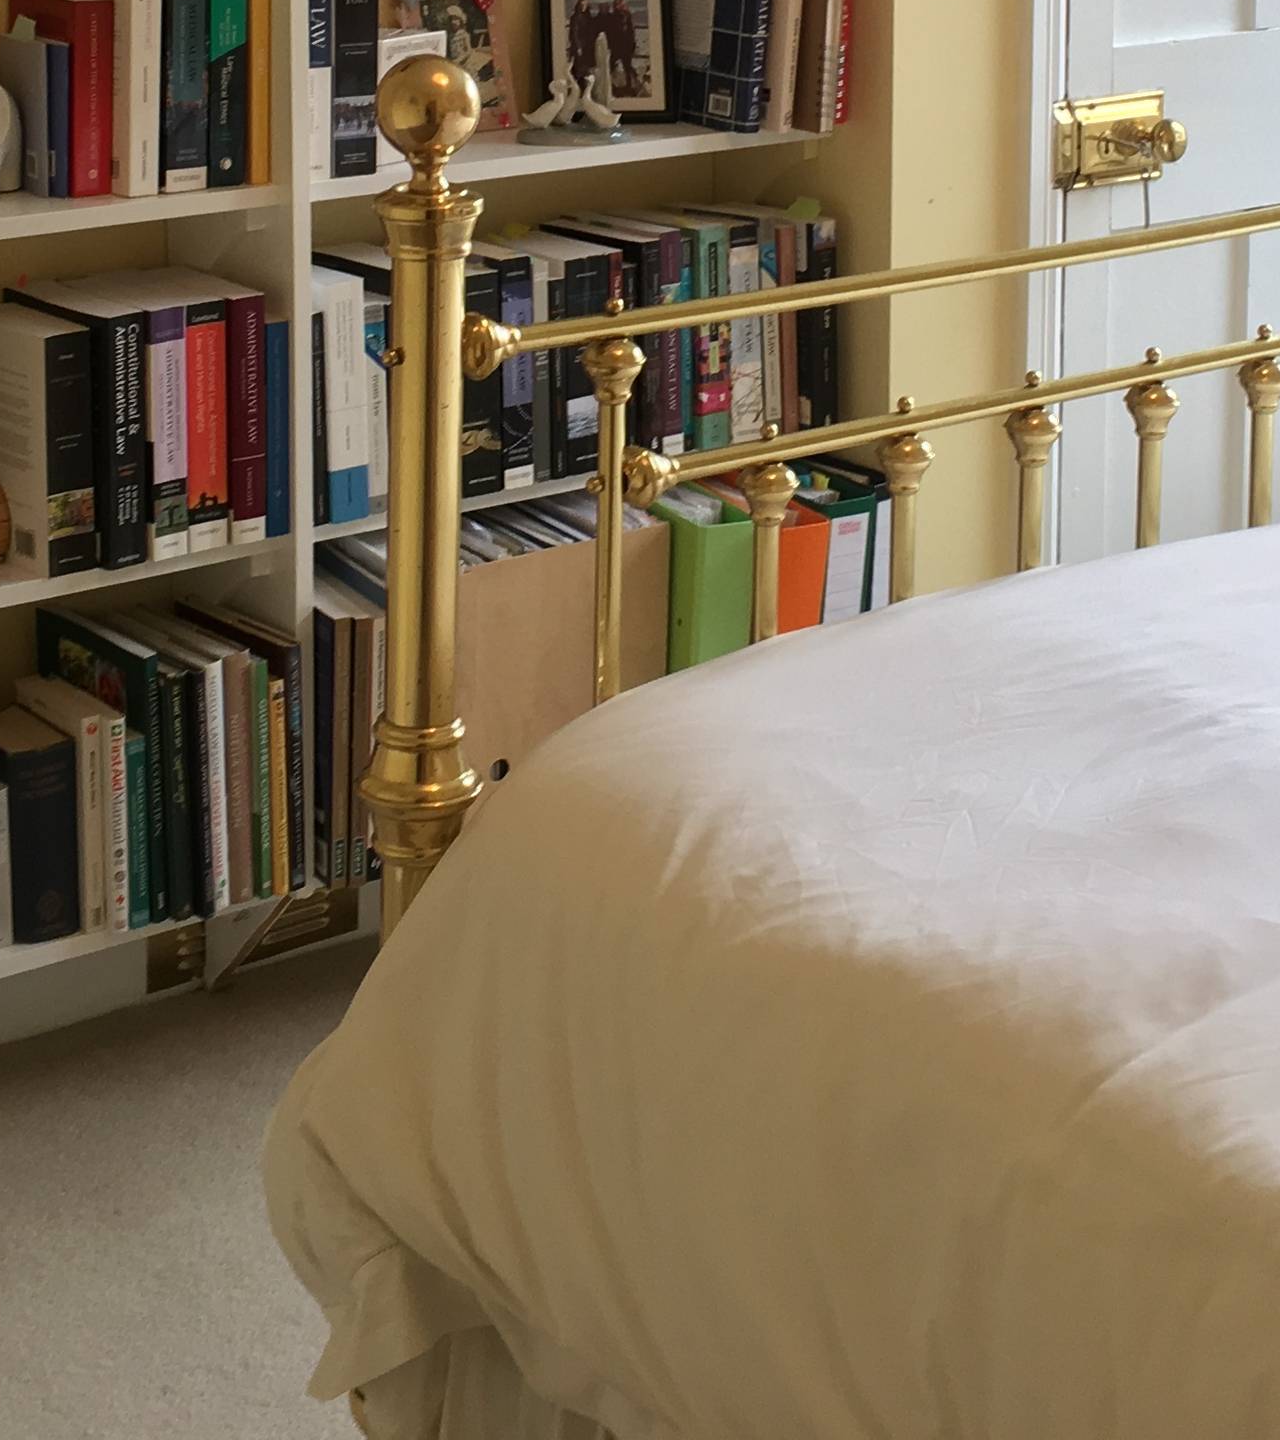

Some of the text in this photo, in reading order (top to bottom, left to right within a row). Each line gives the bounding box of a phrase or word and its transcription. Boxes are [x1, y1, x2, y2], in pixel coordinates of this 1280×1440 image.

[310, 7, 326, 49] LAW
[114, 326, 127, 456] Administrative Law
[127, 323, 141, 436] Constitutional &
[165, 349, 175, 439] ADMINISTRATIVE
[246, 311, 258, 444] ADMINISTRATIVE LAW
[668, 385, 678, 411] LAW
[111, 793, 125, 845] Manual
[209, 675, 223, 877] NIGELLA LAWSON FOREVER SUMMER
